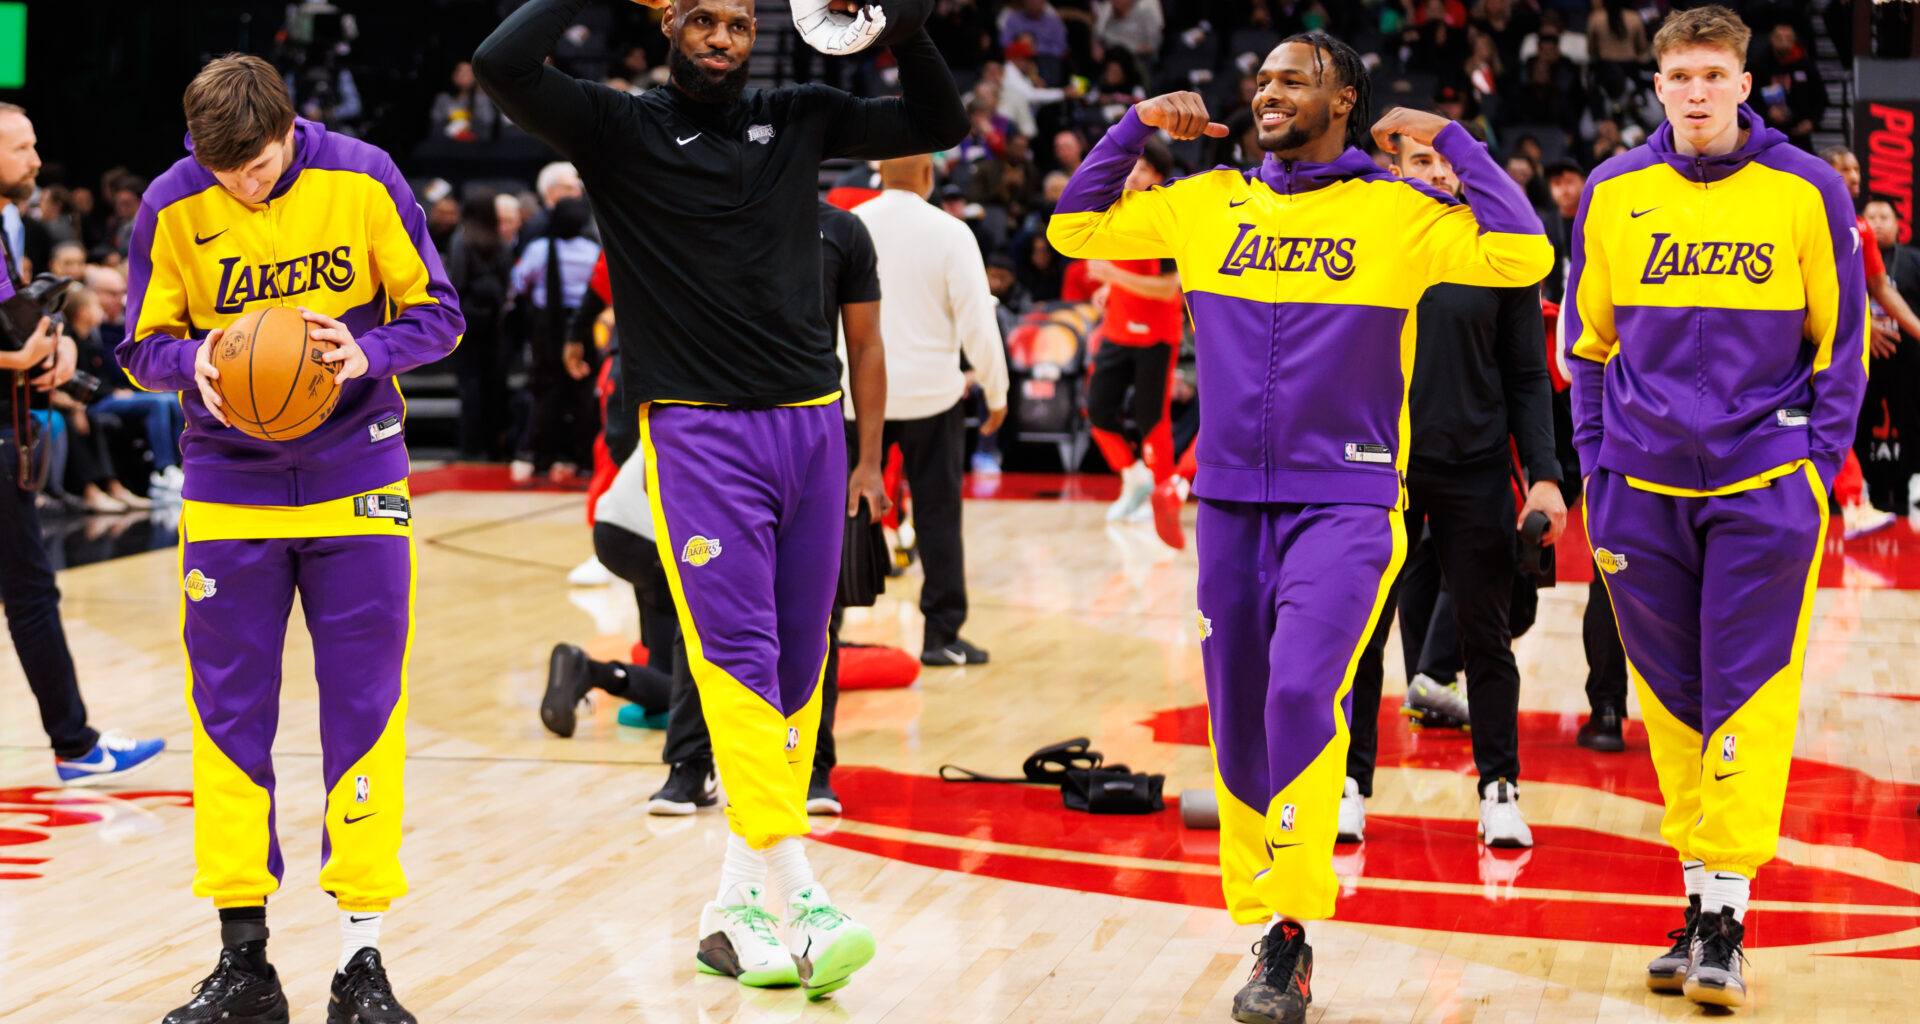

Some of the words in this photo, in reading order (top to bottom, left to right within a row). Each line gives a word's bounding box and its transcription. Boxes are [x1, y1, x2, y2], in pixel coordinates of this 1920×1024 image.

[214, 246, 356, 314] LAKERS
[1218, 223, 1356, 281] LAKERS
[1640, 233, 1775, 285] LAKERS
